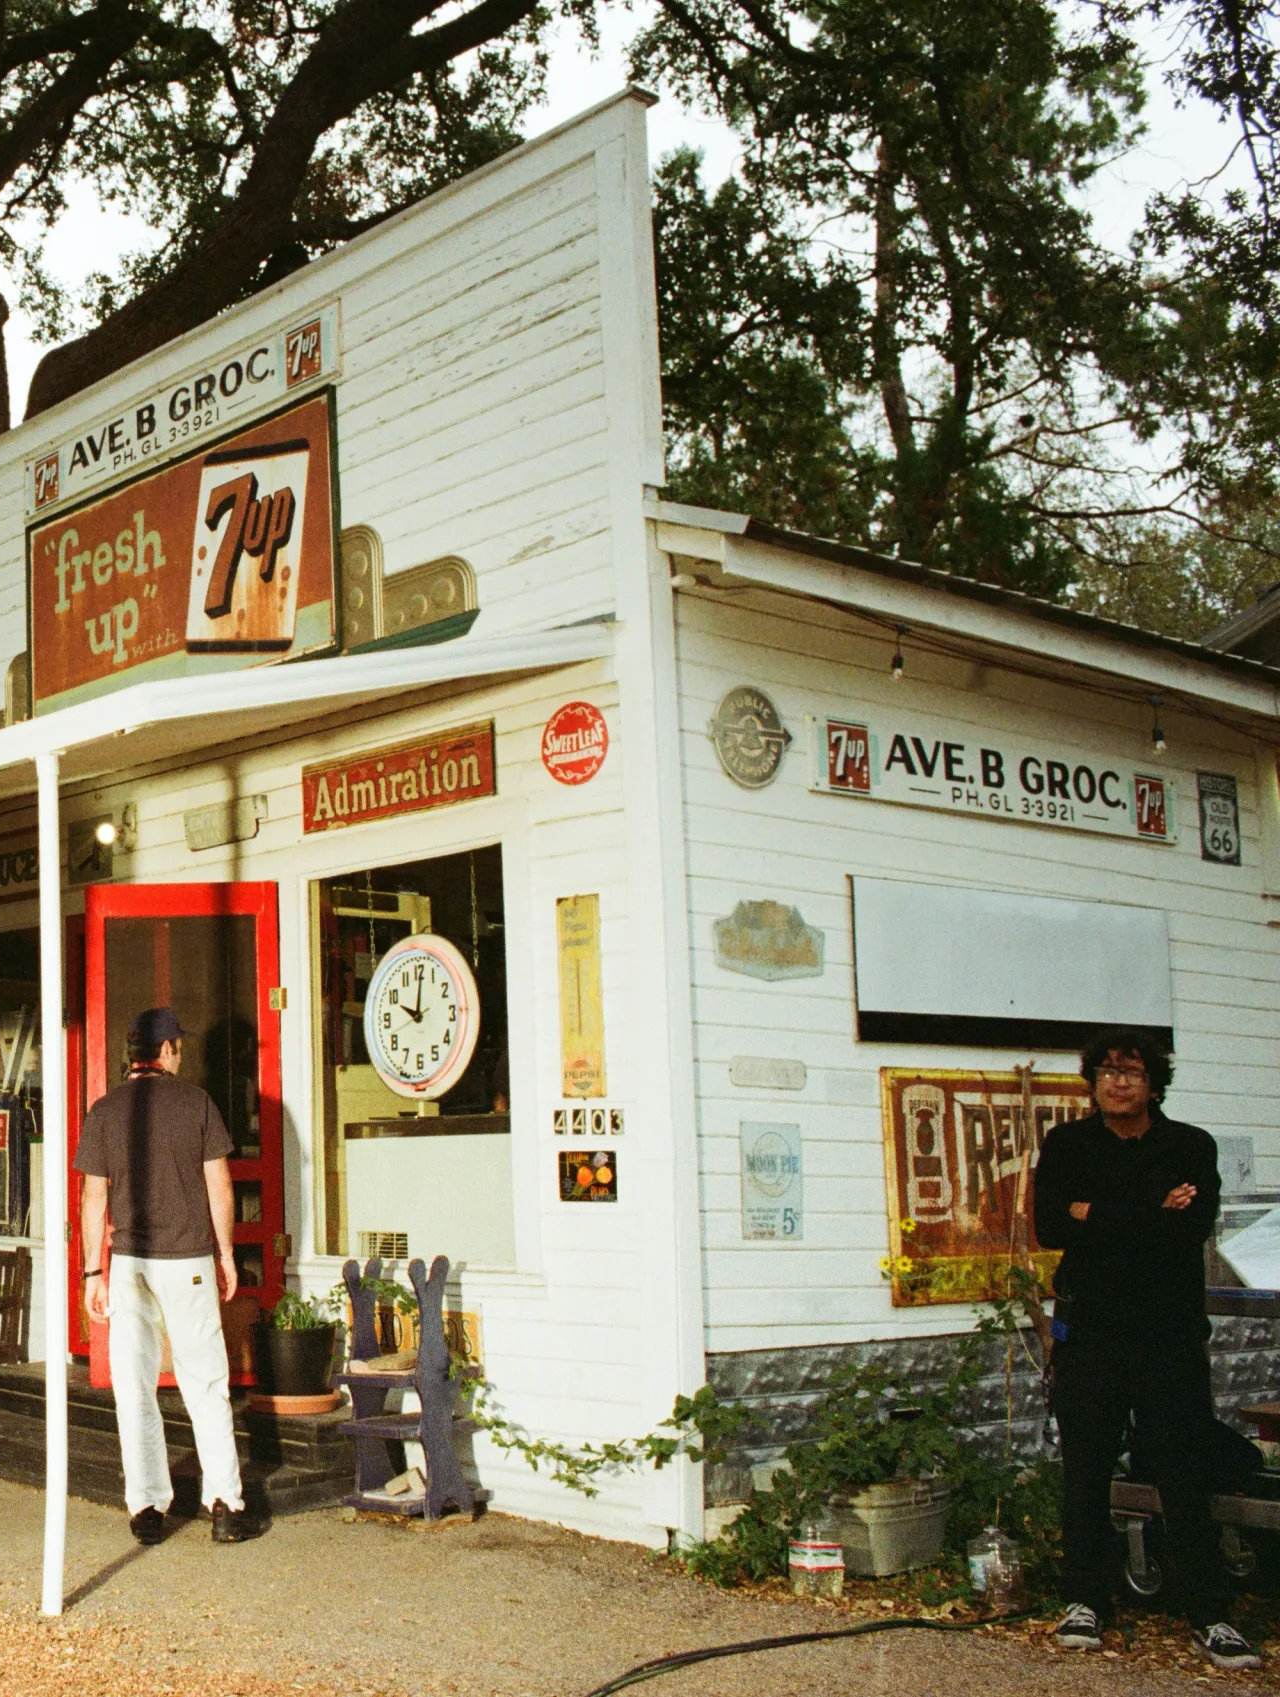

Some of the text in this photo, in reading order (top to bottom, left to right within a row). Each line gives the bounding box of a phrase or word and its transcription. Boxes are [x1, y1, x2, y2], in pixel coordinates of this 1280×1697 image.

[136, 404, 157, 441] B
[169, 347, 276, 421] GROC.
[113, 408, 220, 471] PH. GL 3-3921
[131, 627, 180, 660] with
[729, 695, 772, 719] PUBLIC
[312, 747, 481, 823] Admiration
[981, 748, 1005, 788] B
[1020, 757, 1127, 810] GROC.
[953, 786, 1075, 823] PH. GL 3-3921
[1211, 802, 1229, 815] OLD
[1211, 829, 1233, 853] 66
[402, 972, 409, 988] 11
[414, 964, 425, 981] 12
[431, 968, 435, 983] 1
[389, 989, 399, 1005] 10
[441, 982, 449, 998] 2
[384, 1013, 391, 1029] 9
[449, 1005, 456, 1022] 3
[391, 1034, 398, 1051] 8
[443, 1029, 451, 1045] 4
[402, 1048, 410, 1064] 7
[416, 1053, 424, 1070] 6
[431, 1045, 439, 1061] 5
[564, 1070, 600, 1079] PEPSI
[555, 1109, 623, 1135] 4403
[746, 1154, 799, 1174] MOON PIE
